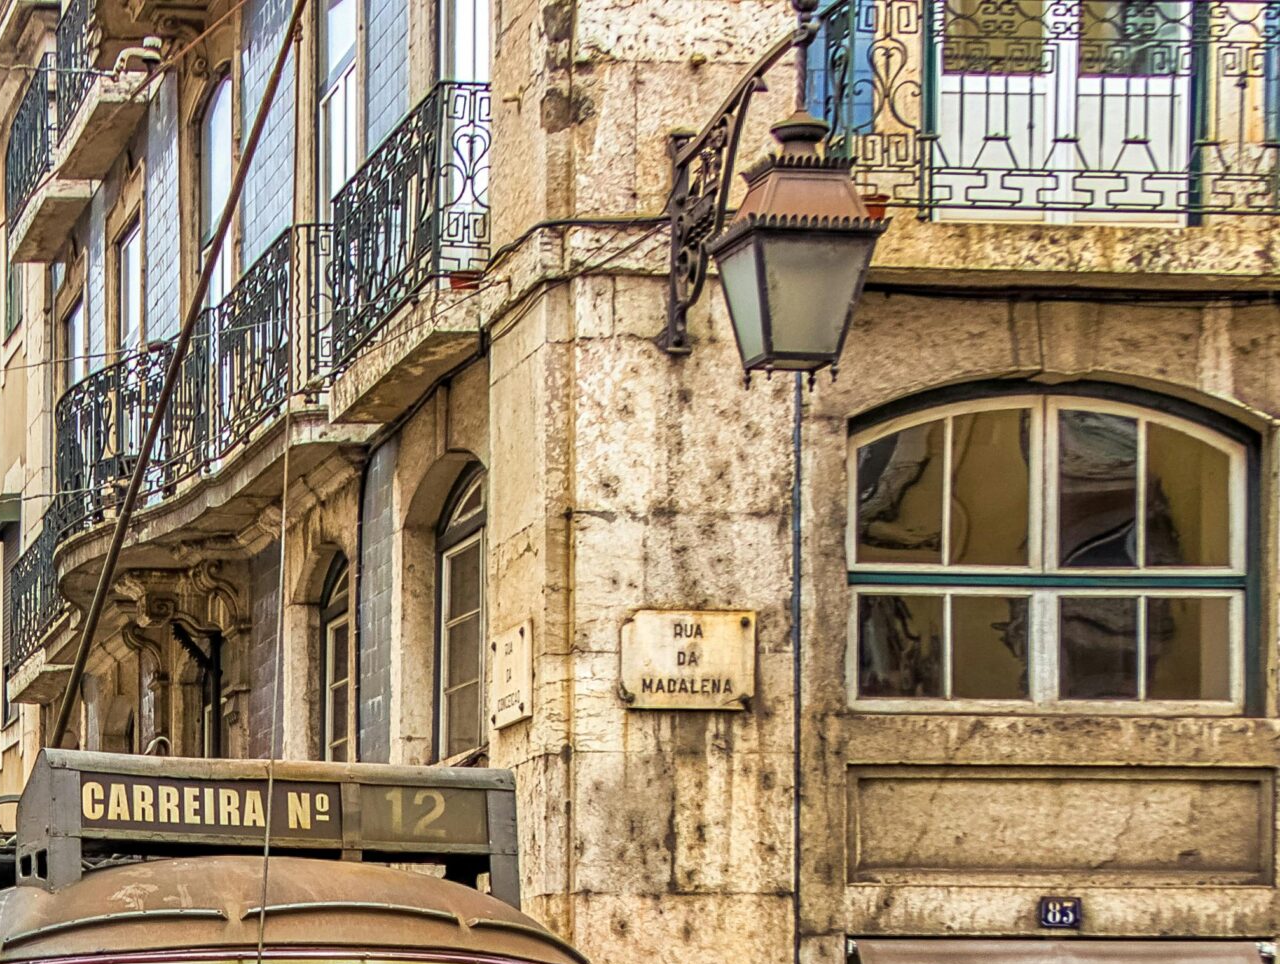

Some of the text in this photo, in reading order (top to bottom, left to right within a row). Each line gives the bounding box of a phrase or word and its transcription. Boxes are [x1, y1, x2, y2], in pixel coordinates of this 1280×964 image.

[673, 623, 704, 639] RUA
[677, 651, 699, 667] DA
[641, 677, 733, 694] MADALENA
[81, 781, 447, 838] CARREIRA Nº 12
